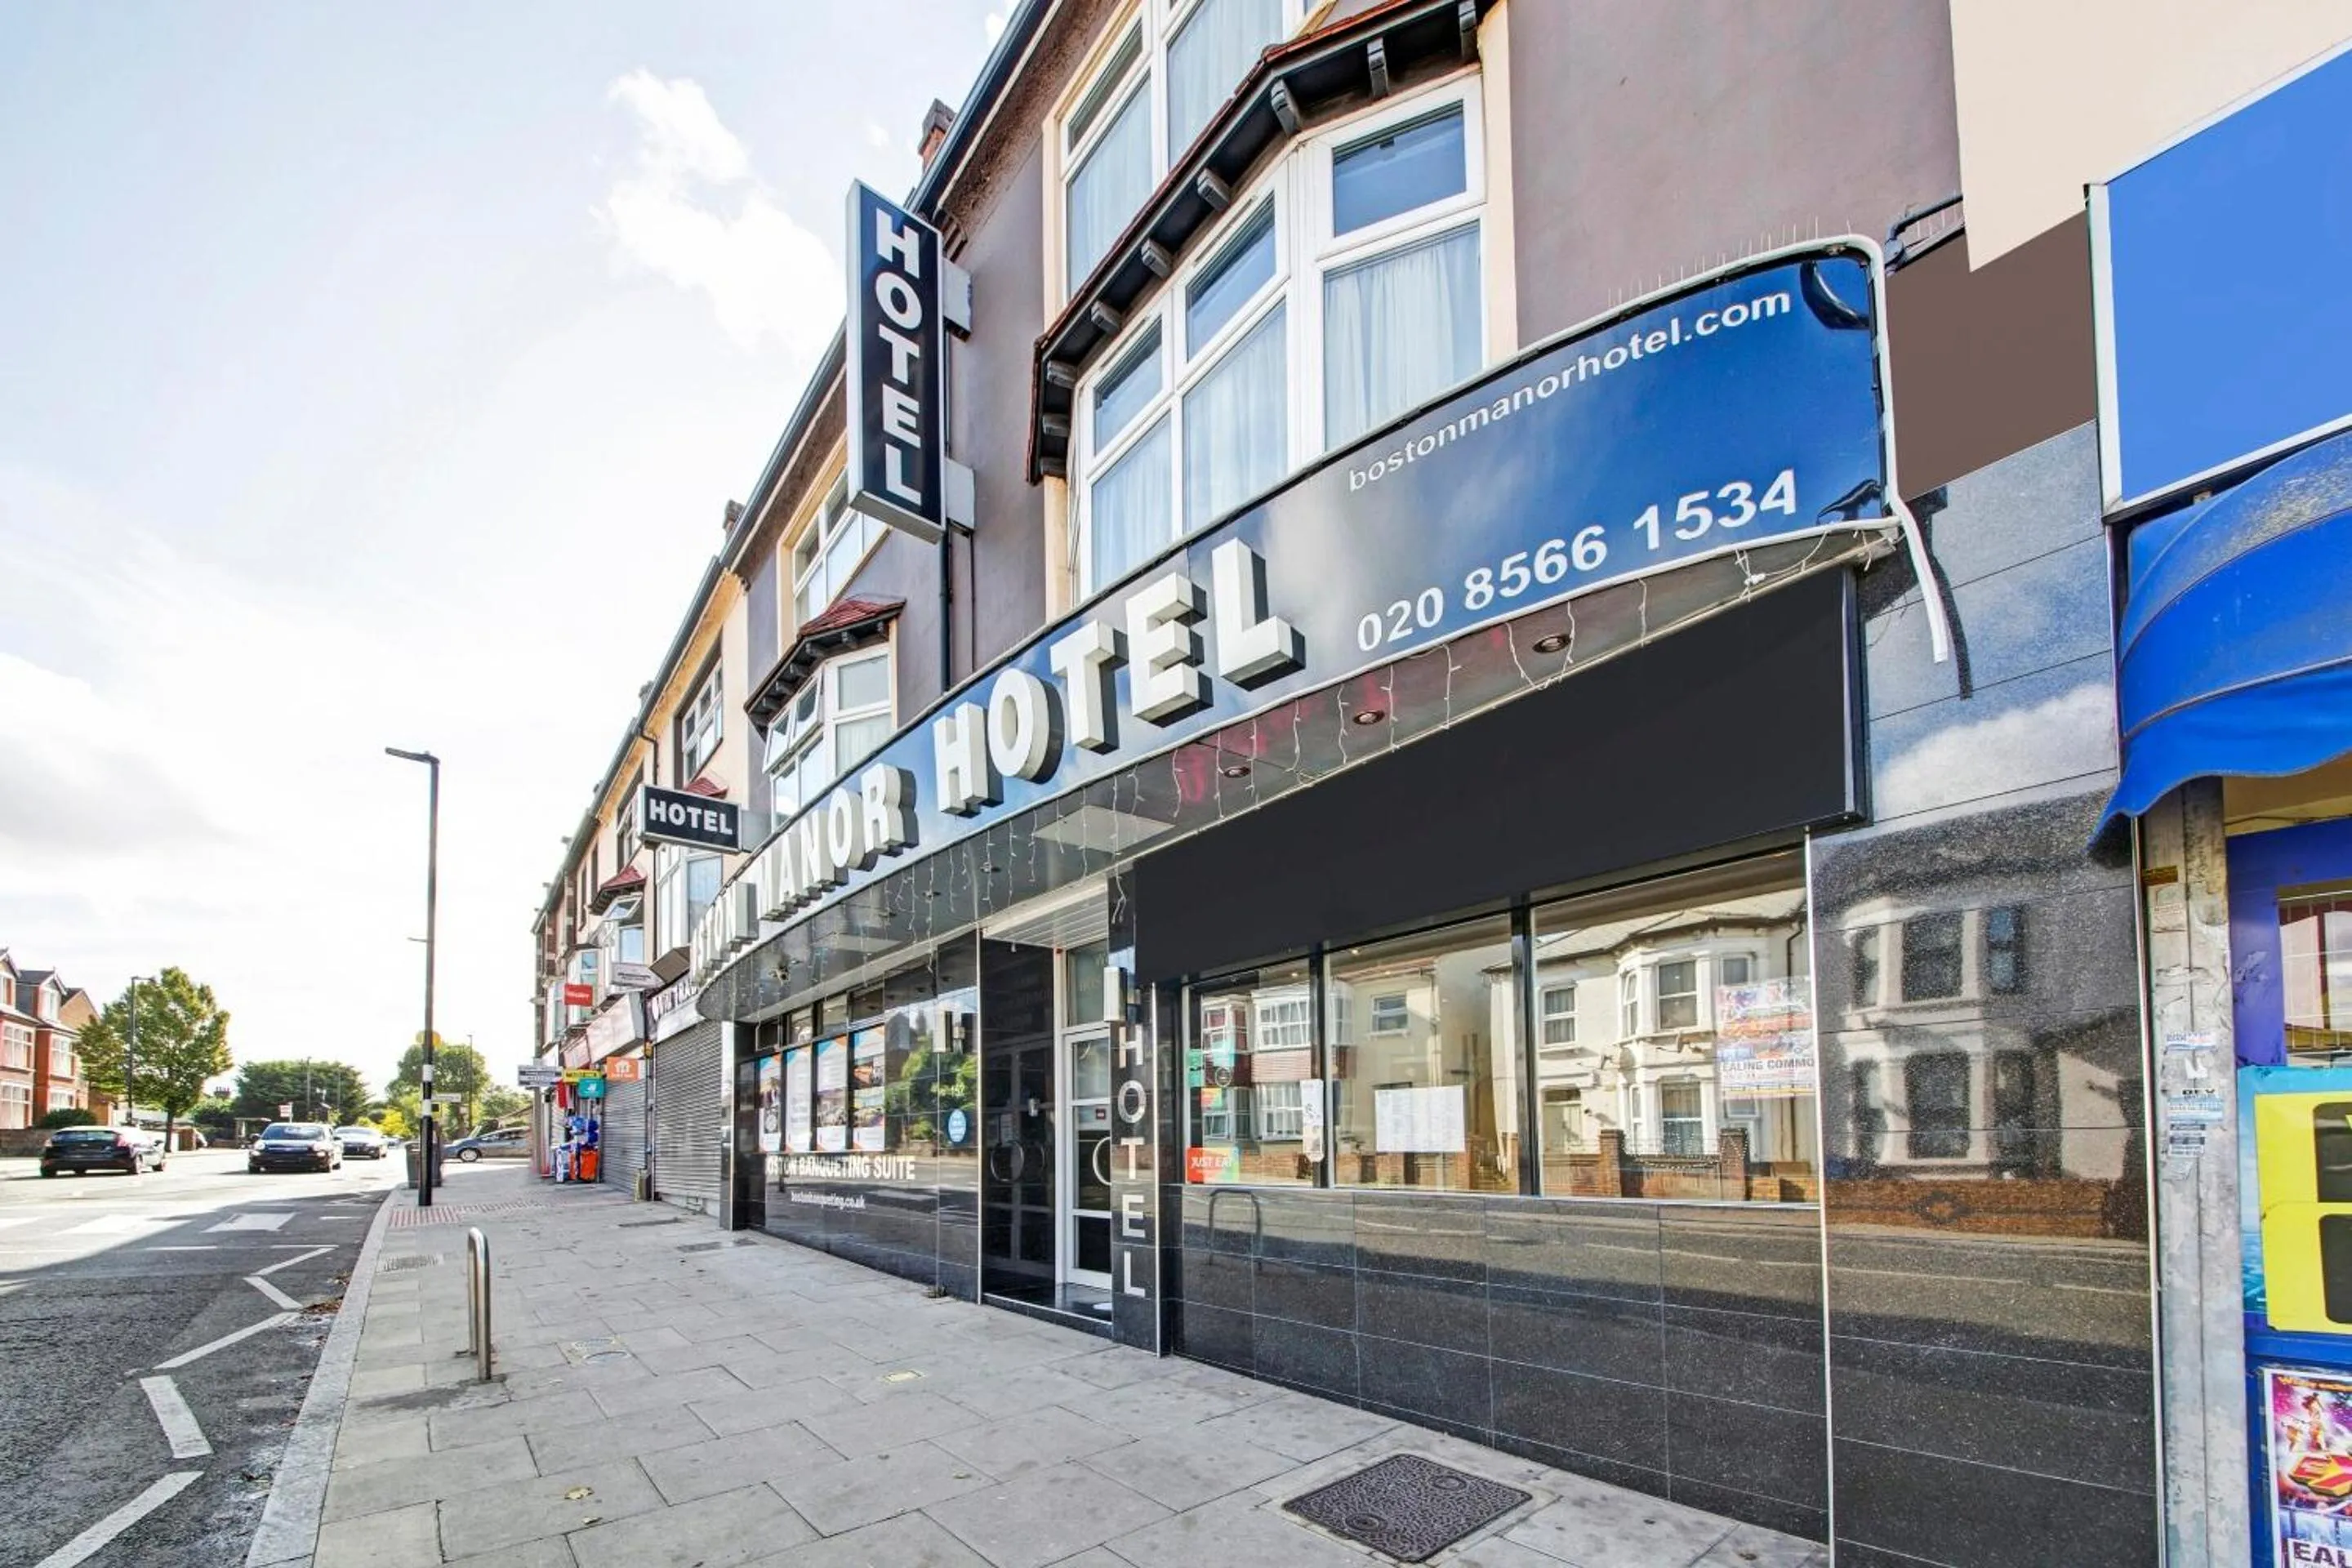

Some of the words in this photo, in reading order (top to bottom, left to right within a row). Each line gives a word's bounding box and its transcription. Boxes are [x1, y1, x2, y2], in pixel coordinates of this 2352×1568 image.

[875, 207, 923, 506] HOTEL
[1349, 289, 1791, 492] bostonmanorhotel.com
[1357, 586, 1444, 652] 020
[1463, 524, 1608, 611] 8566
[1633, 467, 1796, 551] 1534
[933, 537, 1298, 815] HOTEL
[649, 798, 733, 835] HOTEL
[799, 1154, 871, 1179] BANQUETING
[873, 1155, 917, 1181] SUITE
[1117, 1022, 1146, 1298] HOTEL
[1191, 1156, 1213, 1169] JUST
[1214, 1156, 1232, 1168] EAT
